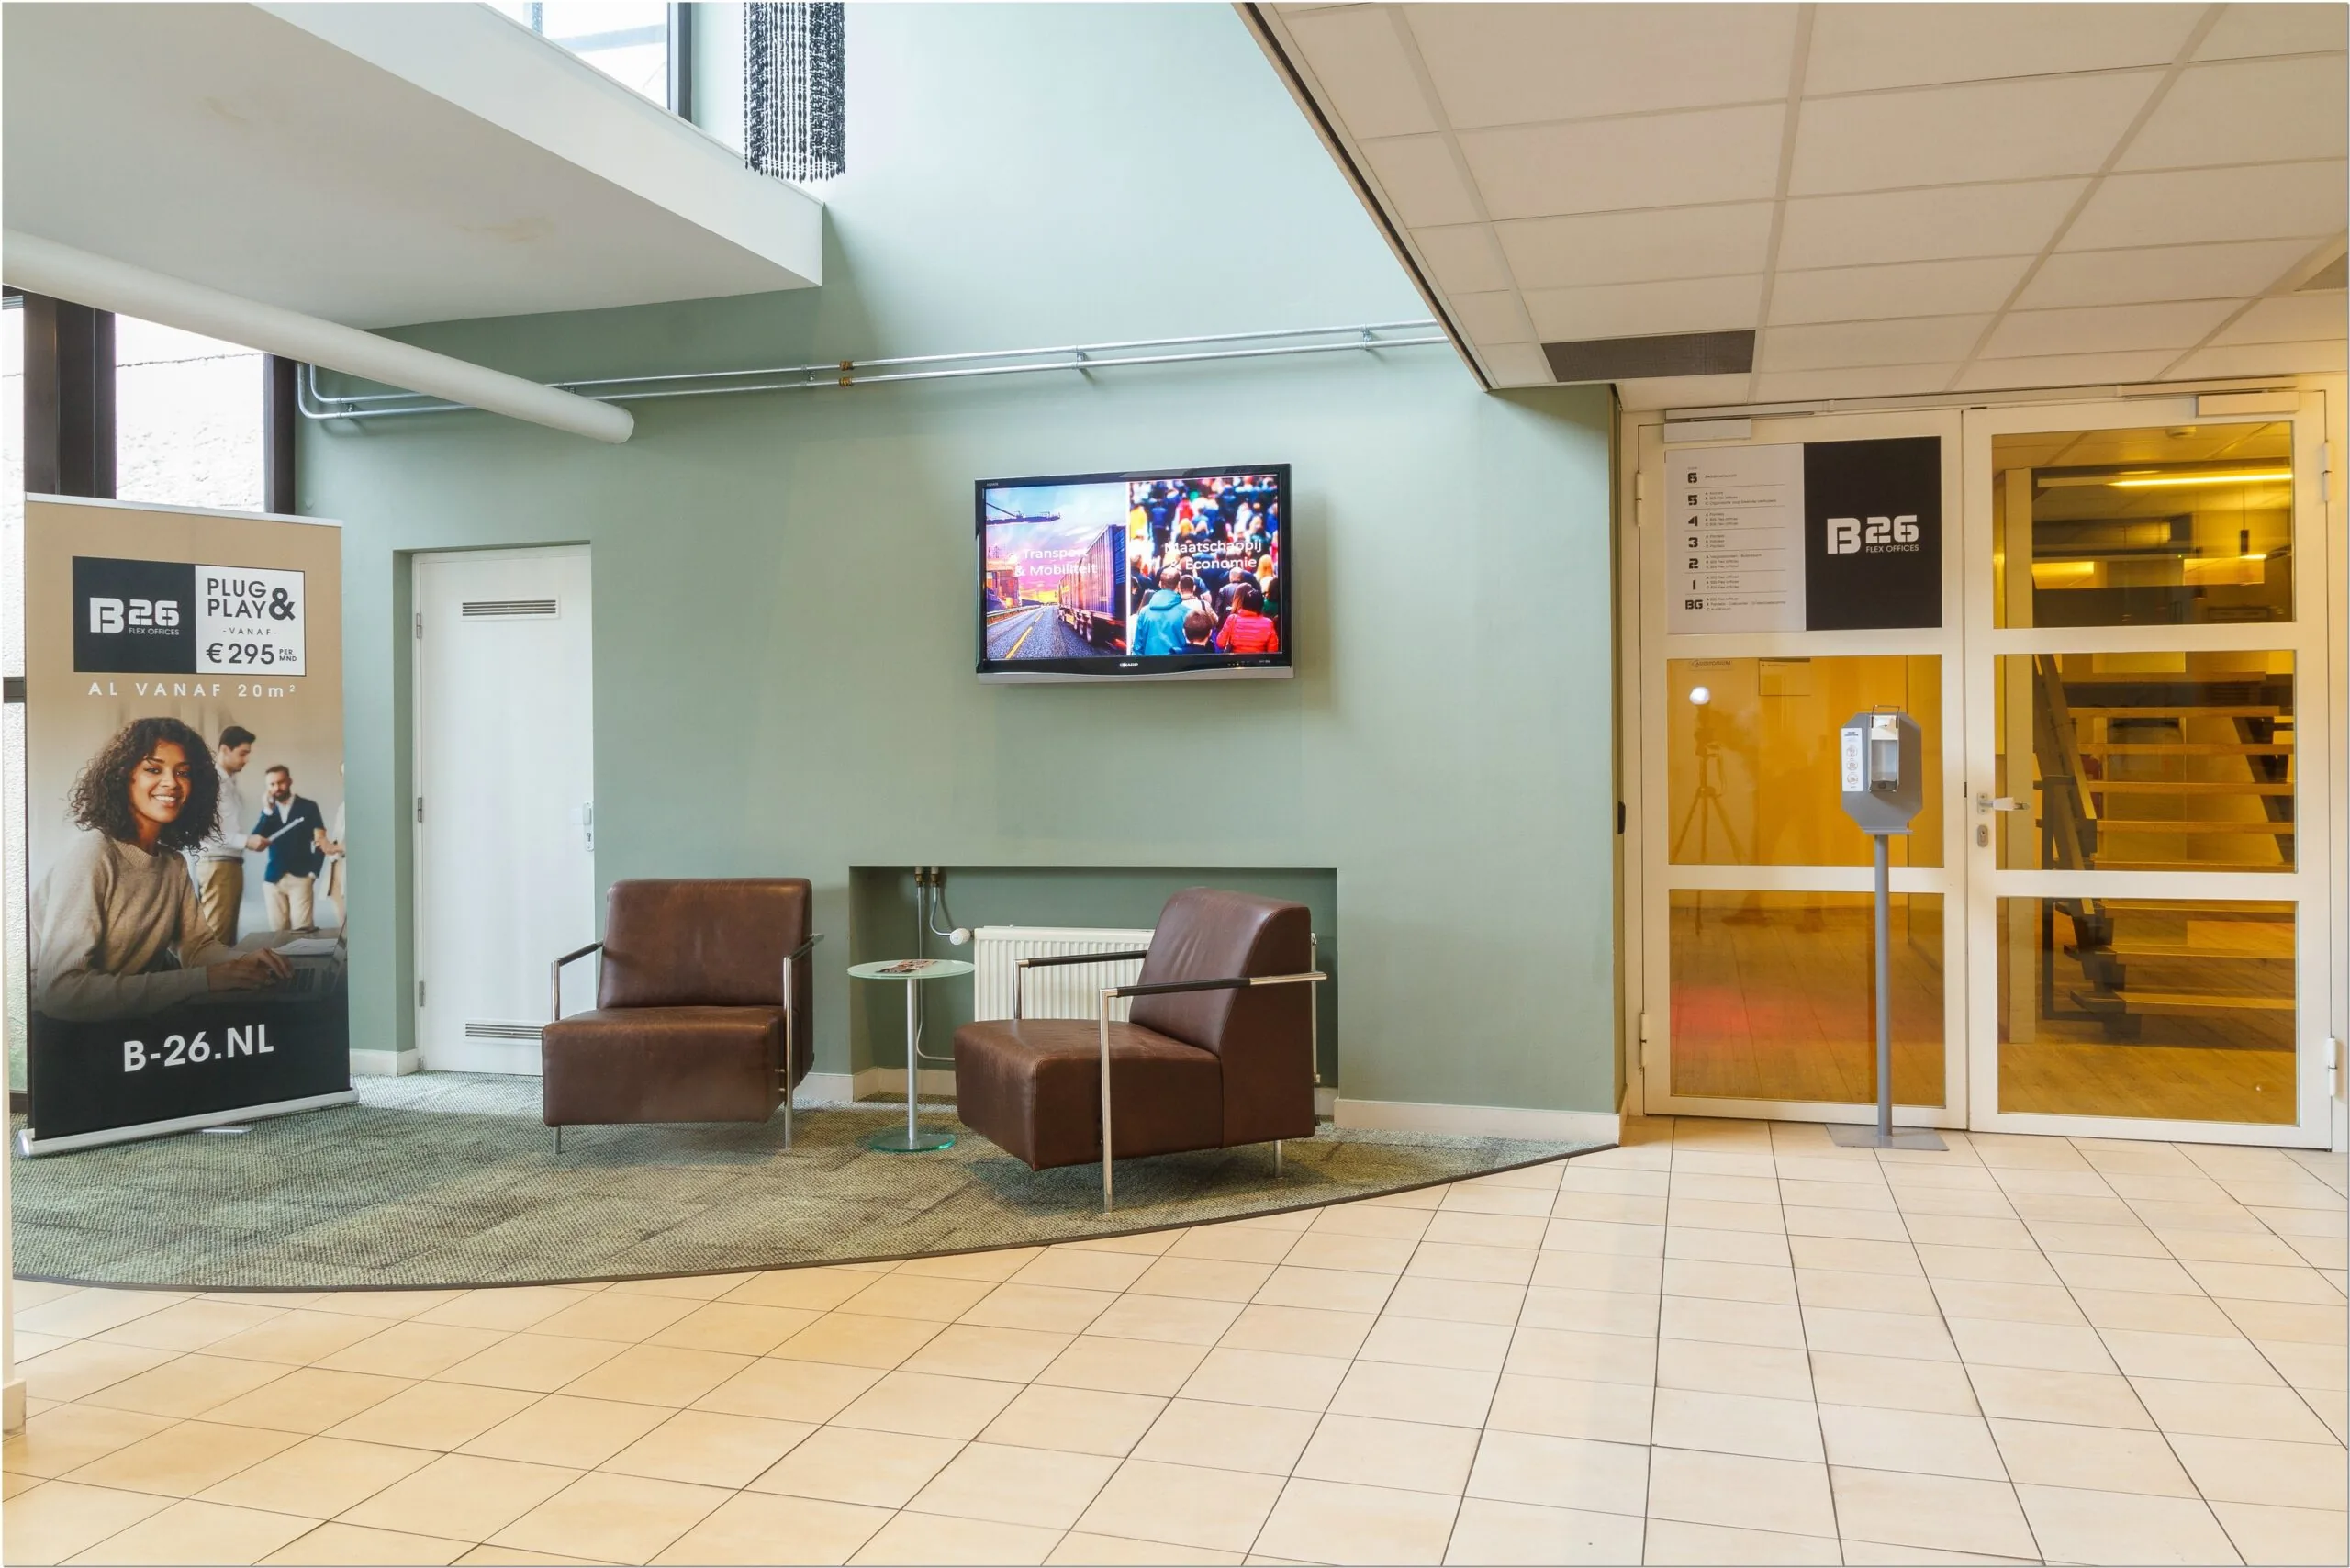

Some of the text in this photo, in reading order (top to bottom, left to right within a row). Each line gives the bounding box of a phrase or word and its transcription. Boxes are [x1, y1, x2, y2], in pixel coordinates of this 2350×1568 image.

[1687, 472, 1697, 484] 6
[1687, 494, 1698, 506] 5
[1687, 515, 1698, 527] 4
[1827, 514, 1919, 554] B26
[1164, 539, 1262, 554] Maatschappij
[1688, 536, 1699, 548] 3
[1865, 544, 1919, 554] FLEX OFFICES
[1014, 562, 1098, 577] & Mobiliteit
[1185, 556, 1257, 570] Economie
[1688, 557, 1699, 569] 2
[207, 577, 296, 621] PLUG &
[1685, 599, 1703, 610] BG
[89, 597, 180, 633] B26
[207, 599, 266, 619] PLAY
[129, 627, 180, 636] FLEX OFFICES
[88, 682, 118, 696] AL
[135, 682, 221, 697] VANAF
[123, 1024, 274, 1072] B-26.NL
